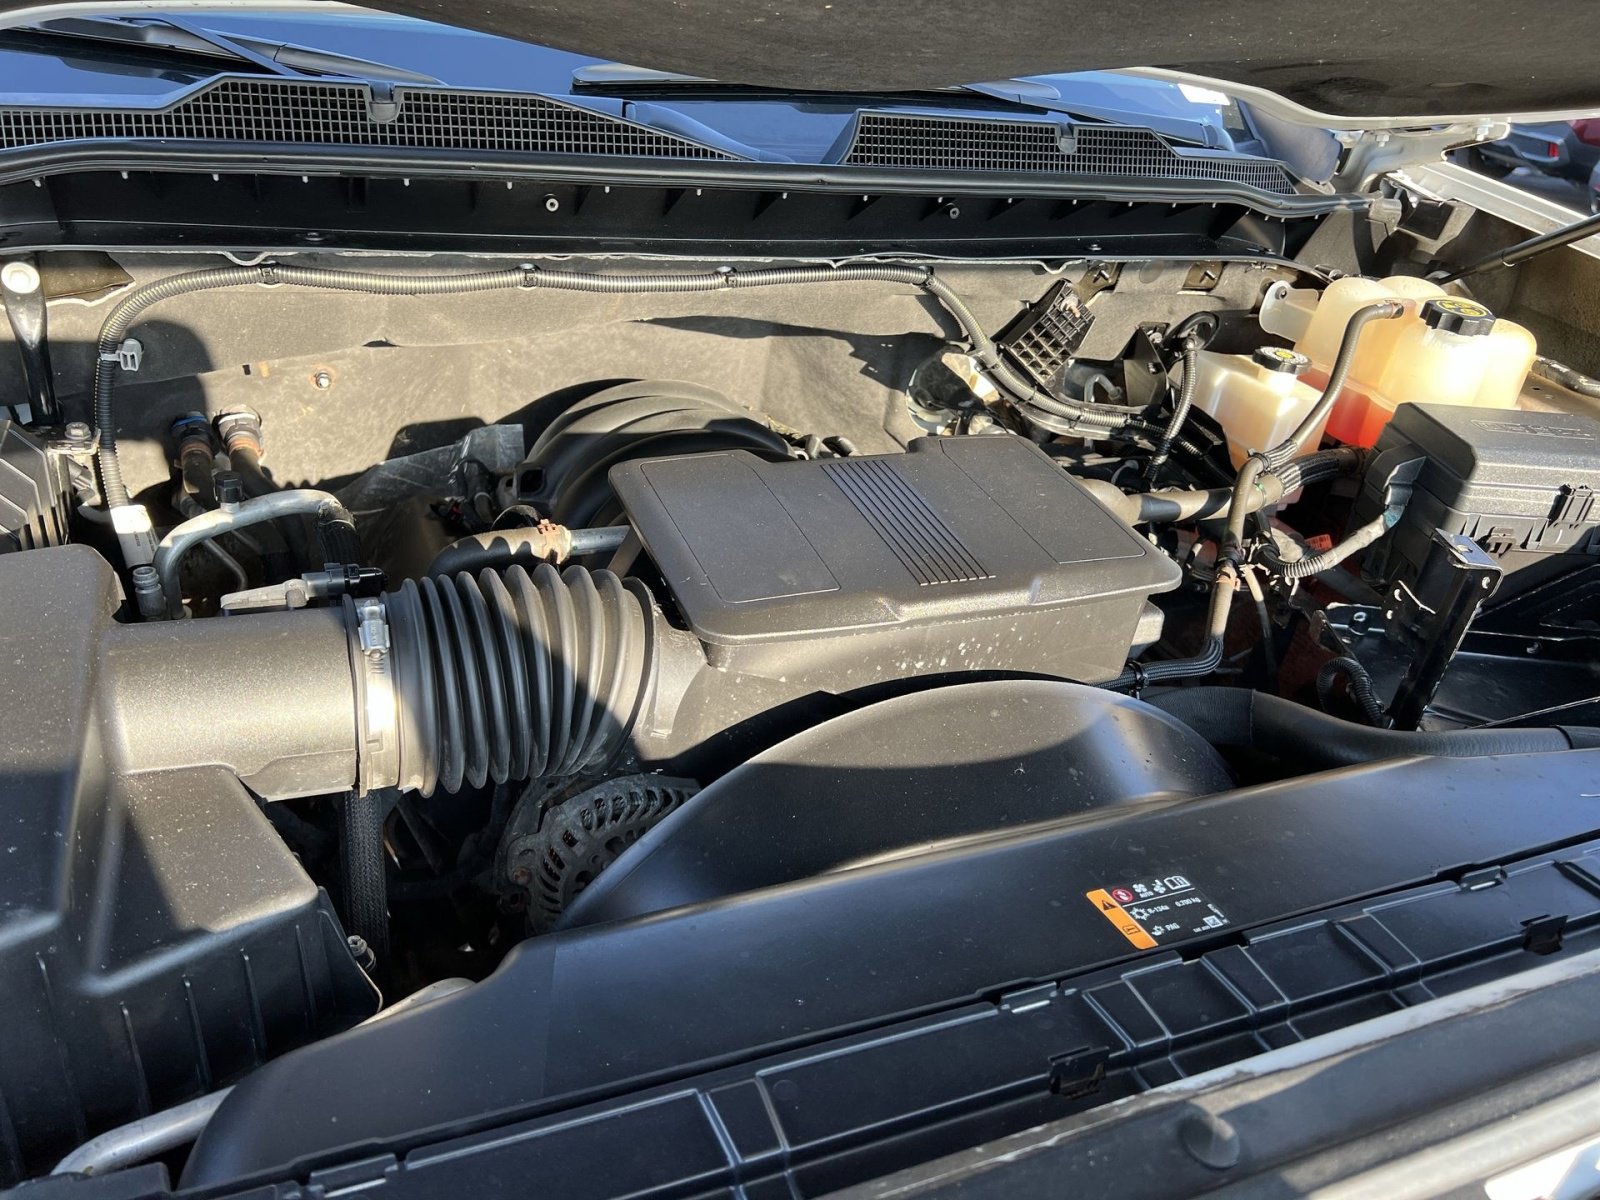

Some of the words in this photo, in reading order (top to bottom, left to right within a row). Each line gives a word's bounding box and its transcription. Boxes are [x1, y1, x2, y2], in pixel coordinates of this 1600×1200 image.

[1139, 890, 1154, 898] AUTO
[1147, 905, 1170, 914] R-134a
[1165, 922, 1180, 931] PAG
